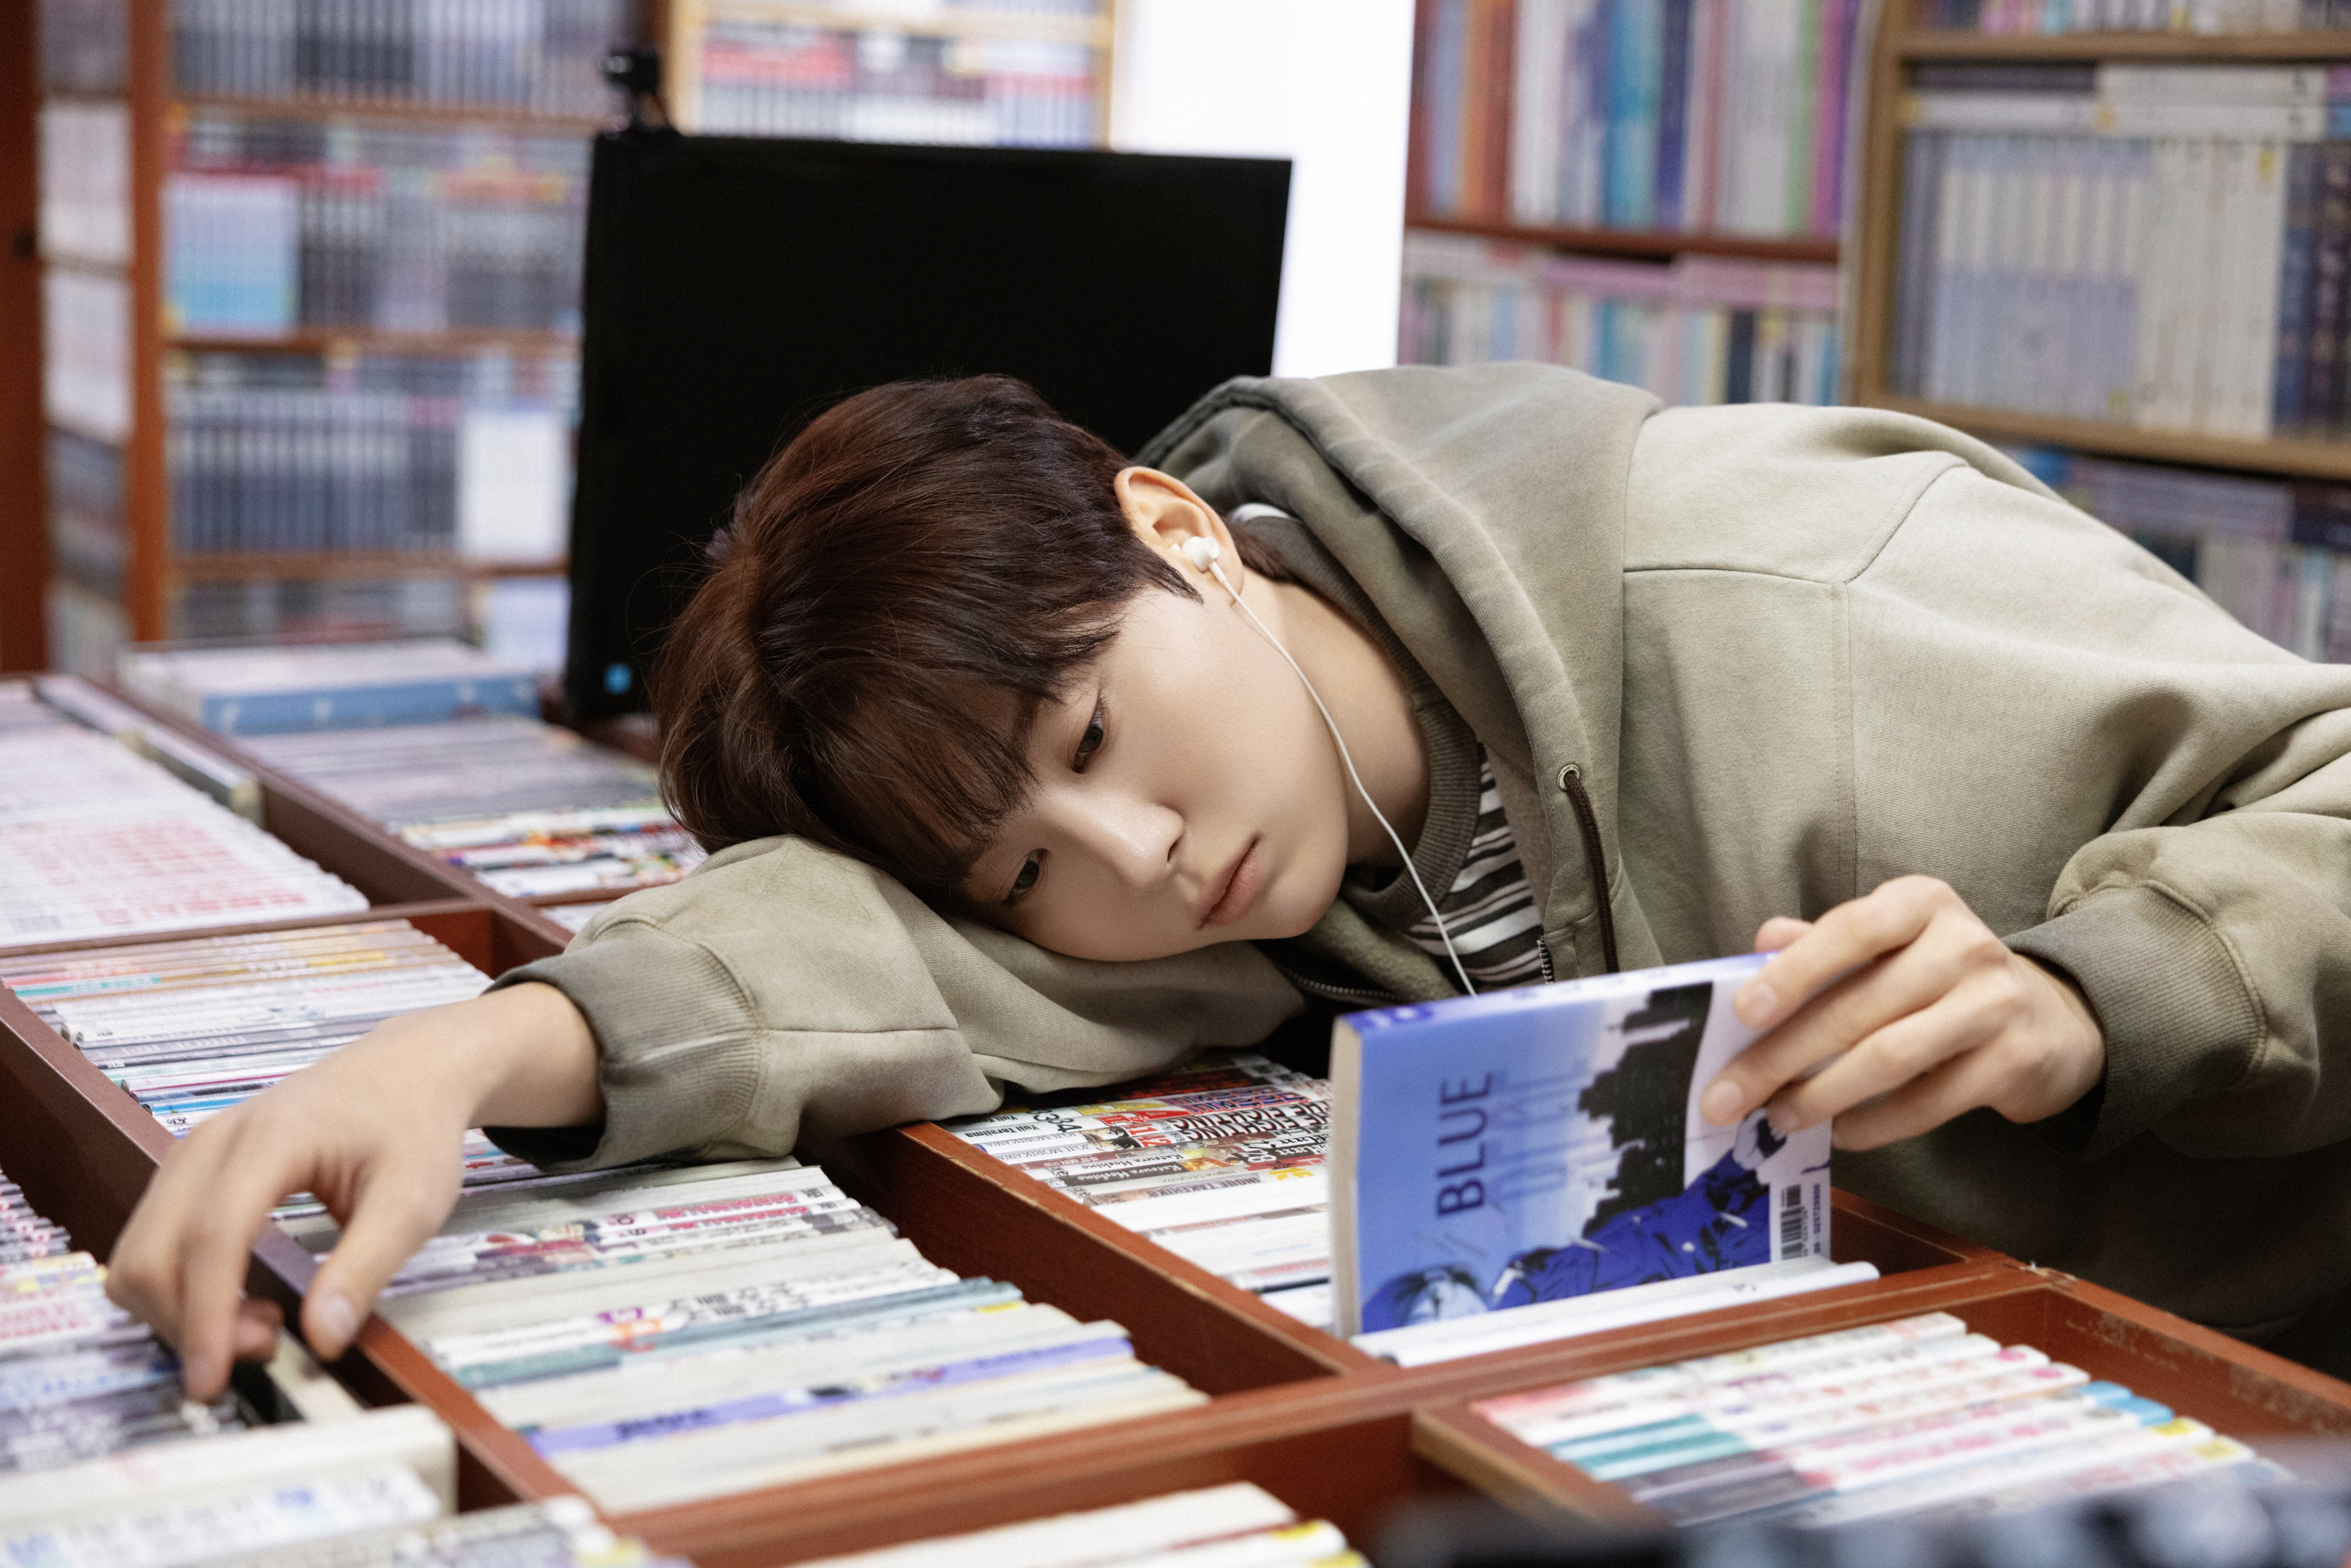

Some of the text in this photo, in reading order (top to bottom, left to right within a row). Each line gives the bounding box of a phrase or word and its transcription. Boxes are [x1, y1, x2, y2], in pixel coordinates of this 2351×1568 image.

[1170, 1107, 1285, 1130] FIGHTING
[964, 1127, 1016, 1138] Terajima
[1183, 1117, 1298, 1141] FIGHTING
[984, 1134, 1048, 1147] MORIKAWA
[1137, 1134, 1171, 1147] 42
[1438, 1074, 1491, 1215] BLUE
[994, 1143, 1089, 1160] JOJI MORIKAWA
[1238, 1148, 1277, 1163] 28
[1081, 1153, 1183, 1170] Katsura Hoshino
[1077, 1170, 1129, 1181] Hoshino
[1128, 1164, 1182, 1175] Katsura
[1160, 1169, 1236, 1184] Hajime SEGAWA
[1148, 1177, 1260, 1198] INOUE TAKEHIKO
